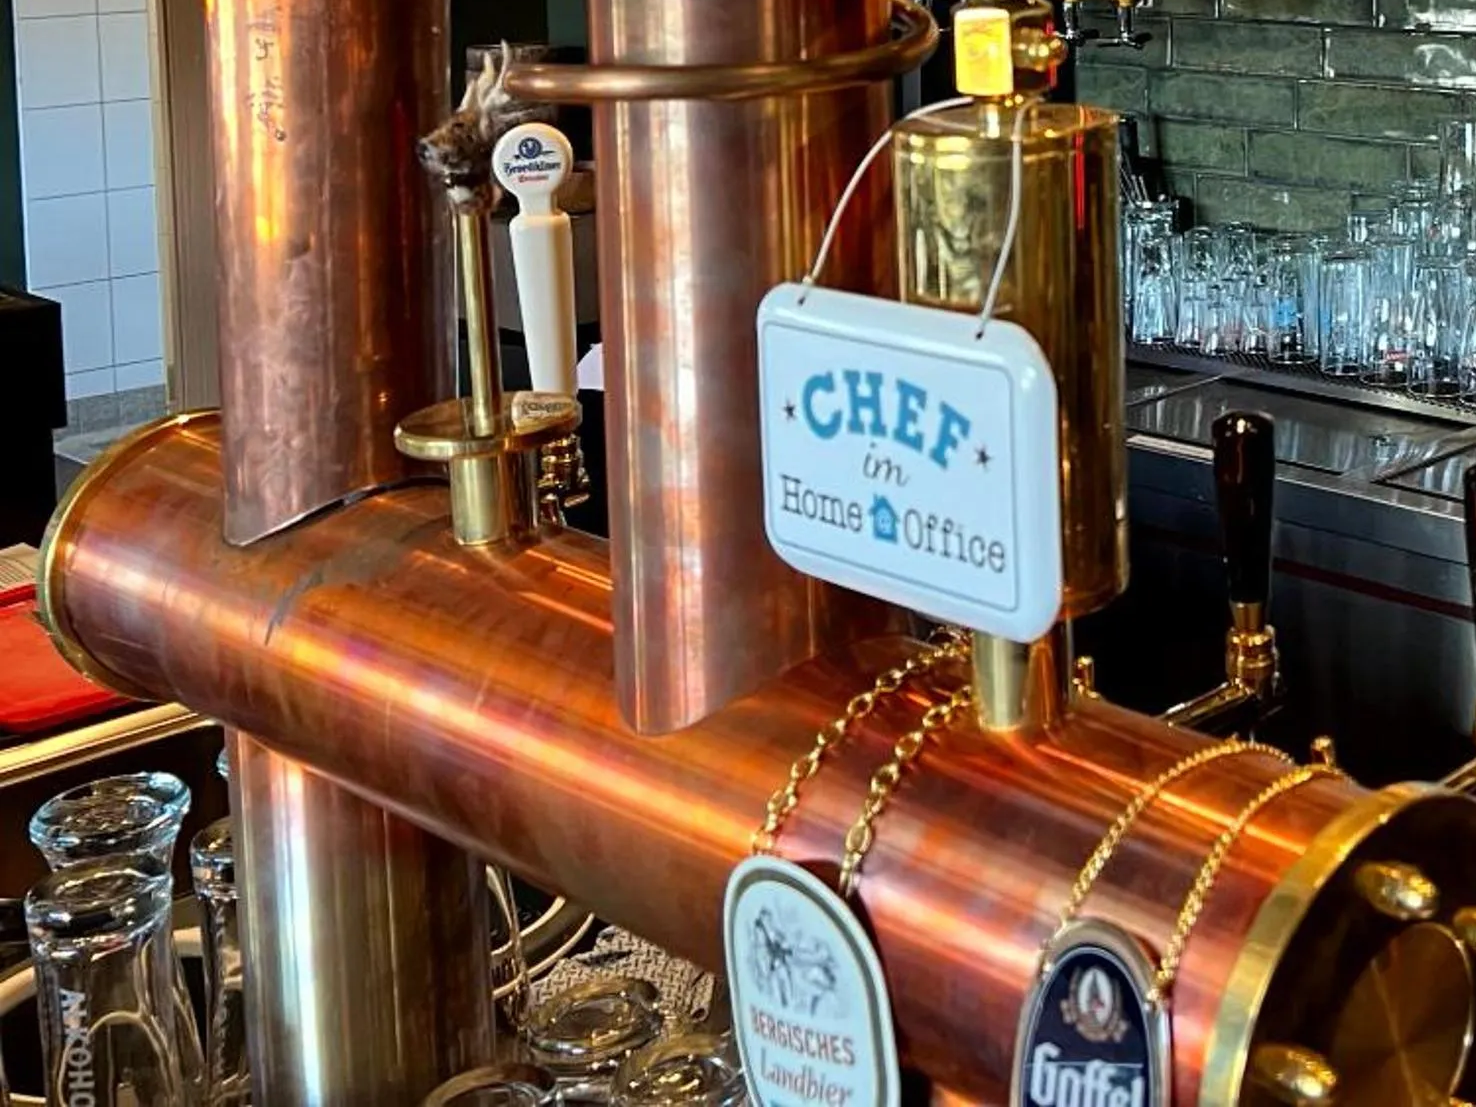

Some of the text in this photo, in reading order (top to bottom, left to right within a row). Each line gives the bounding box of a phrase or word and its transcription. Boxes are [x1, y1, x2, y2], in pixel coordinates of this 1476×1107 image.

[802, 369, 971, 470] CHEF
[862, 442, 911, 488] in
[779, 473, 1006, 574] Home Office
[750, 1004, 856, 1067] BERGISCHES
[760, 1047, 854, 1107] Landbier
